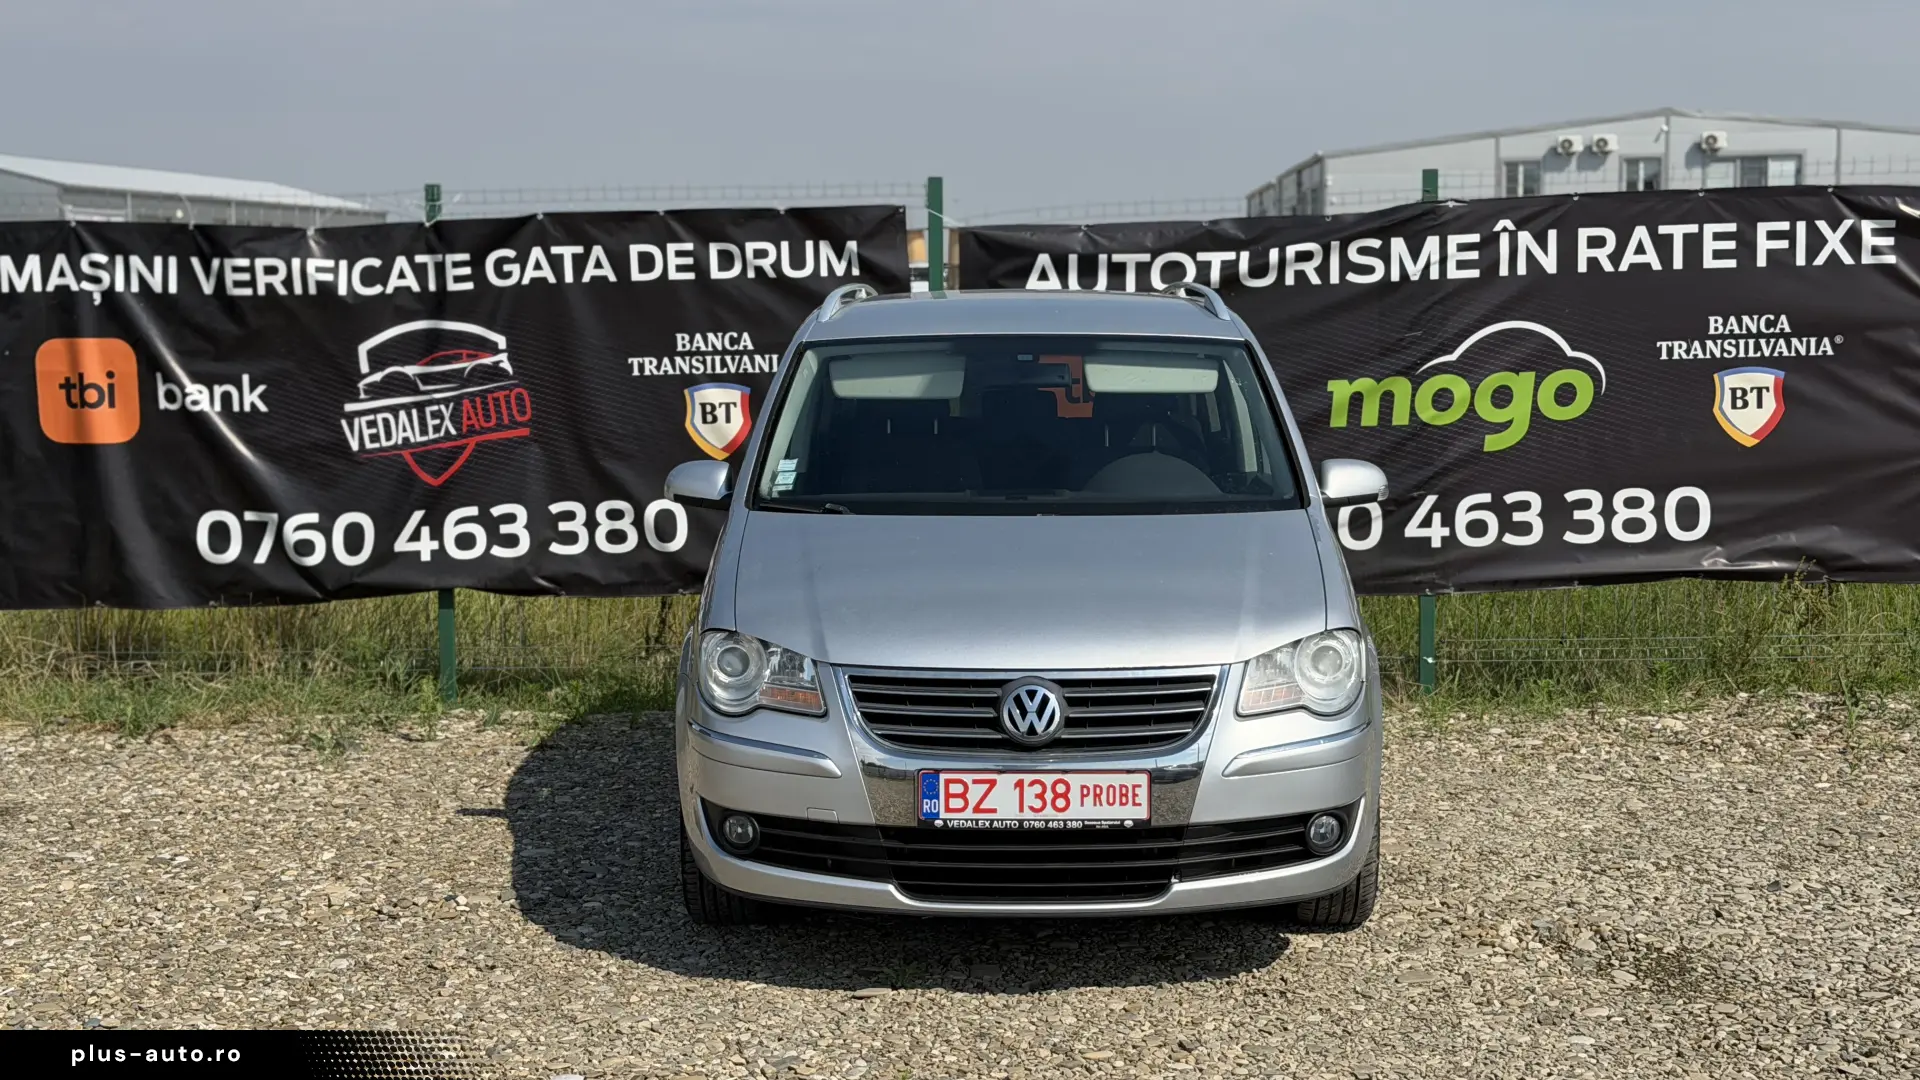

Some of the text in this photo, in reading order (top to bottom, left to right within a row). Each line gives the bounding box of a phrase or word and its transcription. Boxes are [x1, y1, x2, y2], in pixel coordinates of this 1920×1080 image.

[0, 240, 860, 306] MAȘINI VERIFICATE GATA DE DRUM
[1025, 218, 1898, 293] AUTOTURISME ÎN RATE FIXE
[675, 331, 755, 352] BANCA
[1707, 314, 1792, 335] BANCA
[627, 354, 780, 377] TRANSILVANI
[59, 371, 269, 413] tbi bank
[1729, 386, 1770, 411] BT
[340, 387, 532, 452] VEDALEX AUTO
[699, 402, 738, 425] BT
[1327, 368, 1595, 453] mogo
[196, 498, 689, 567] 0760 463 380
[1404, 490, 1544, 549] 463
[1562, 486, 1711, 544] 380
[923, 799, 939, 813] RO
[943, 778, 1142, 814] BZ 138 PROBE
[946, 819, 991, 829] VEDALEX
[993, 820, 1019, 829] AUTO
[1023, 820, 1046, 829] 0760
[1047, 820, 1064, 829] 463
[1065, 820, 1083, 829] 380
